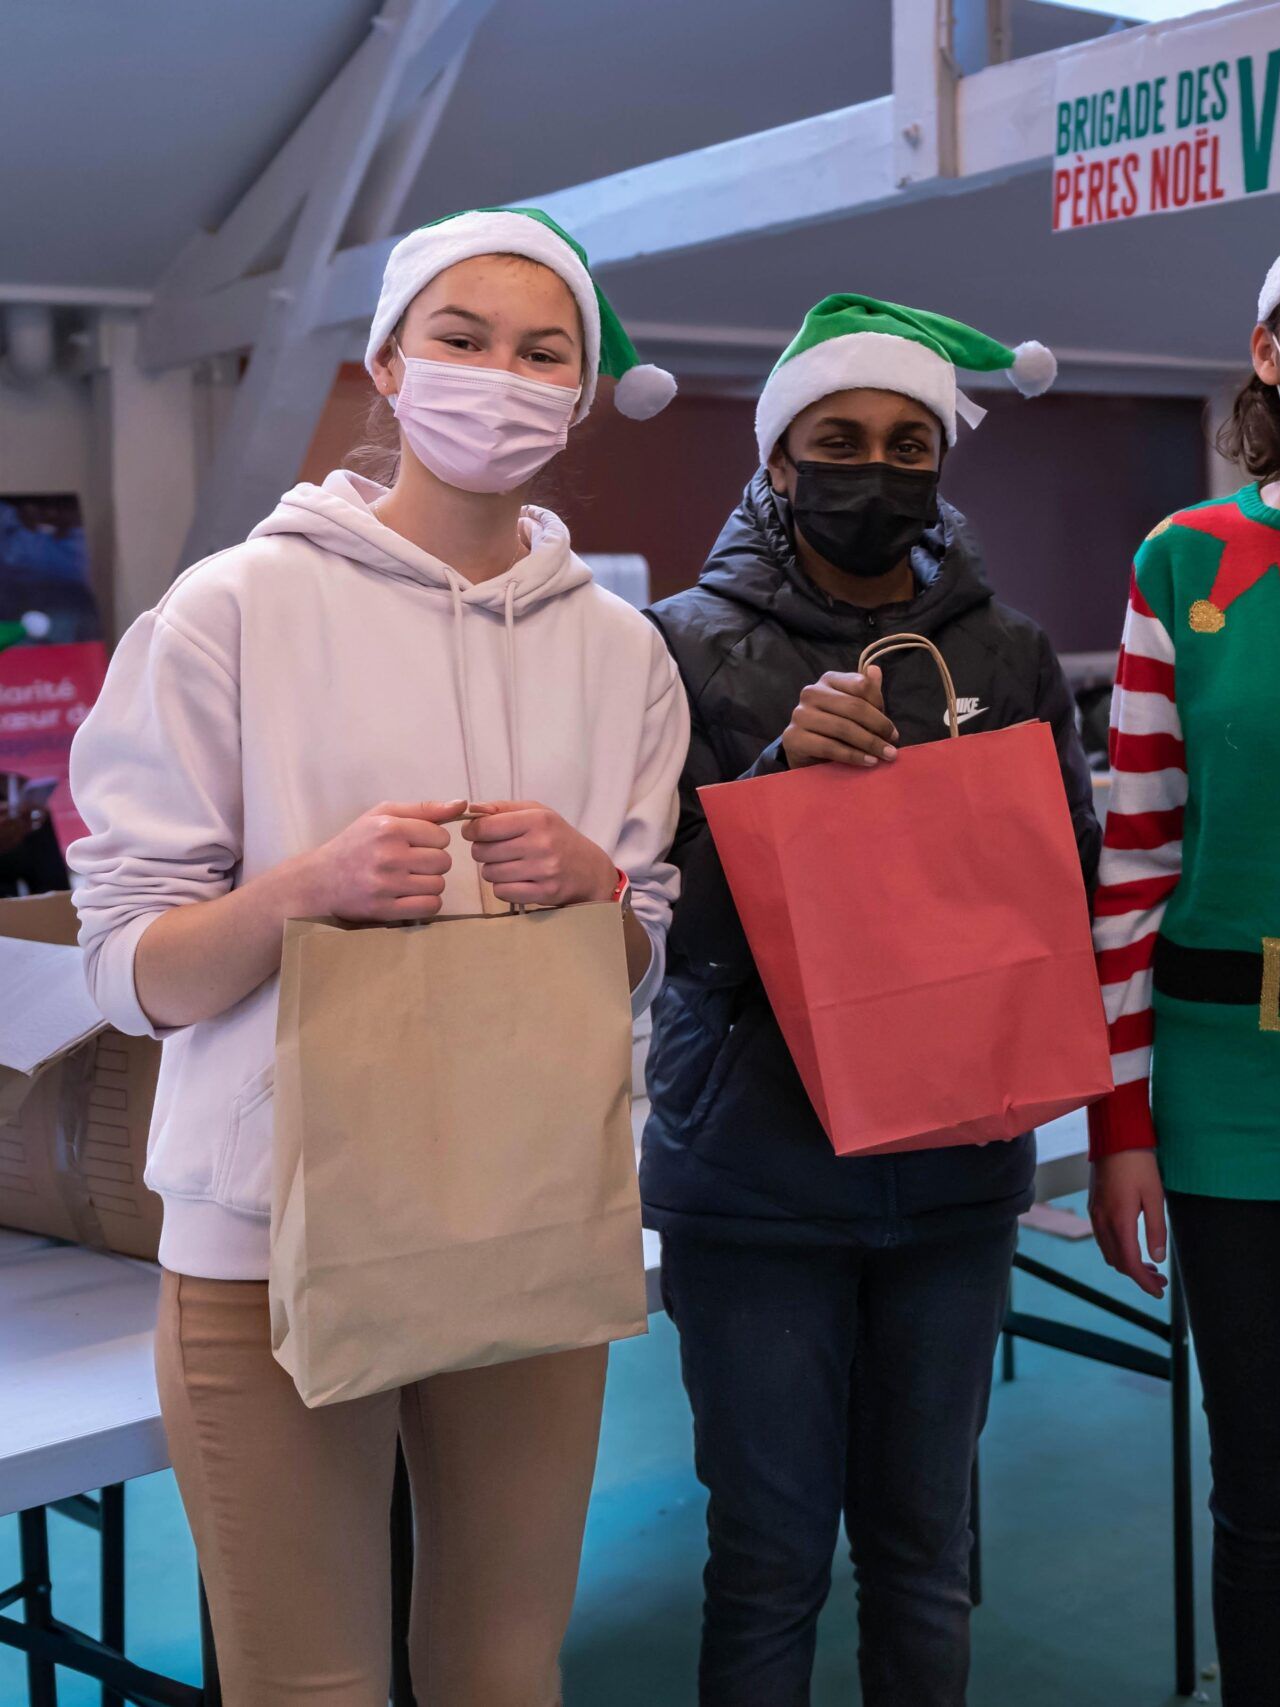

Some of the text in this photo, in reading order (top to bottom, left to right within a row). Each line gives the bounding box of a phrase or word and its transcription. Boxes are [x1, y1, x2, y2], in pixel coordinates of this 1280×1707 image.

[1056, 61, 1229, 156] BRIGADE DES
[1053, 129, 1224, 231] PÈRES NOËL
[0, 677, 76, 705] arité
